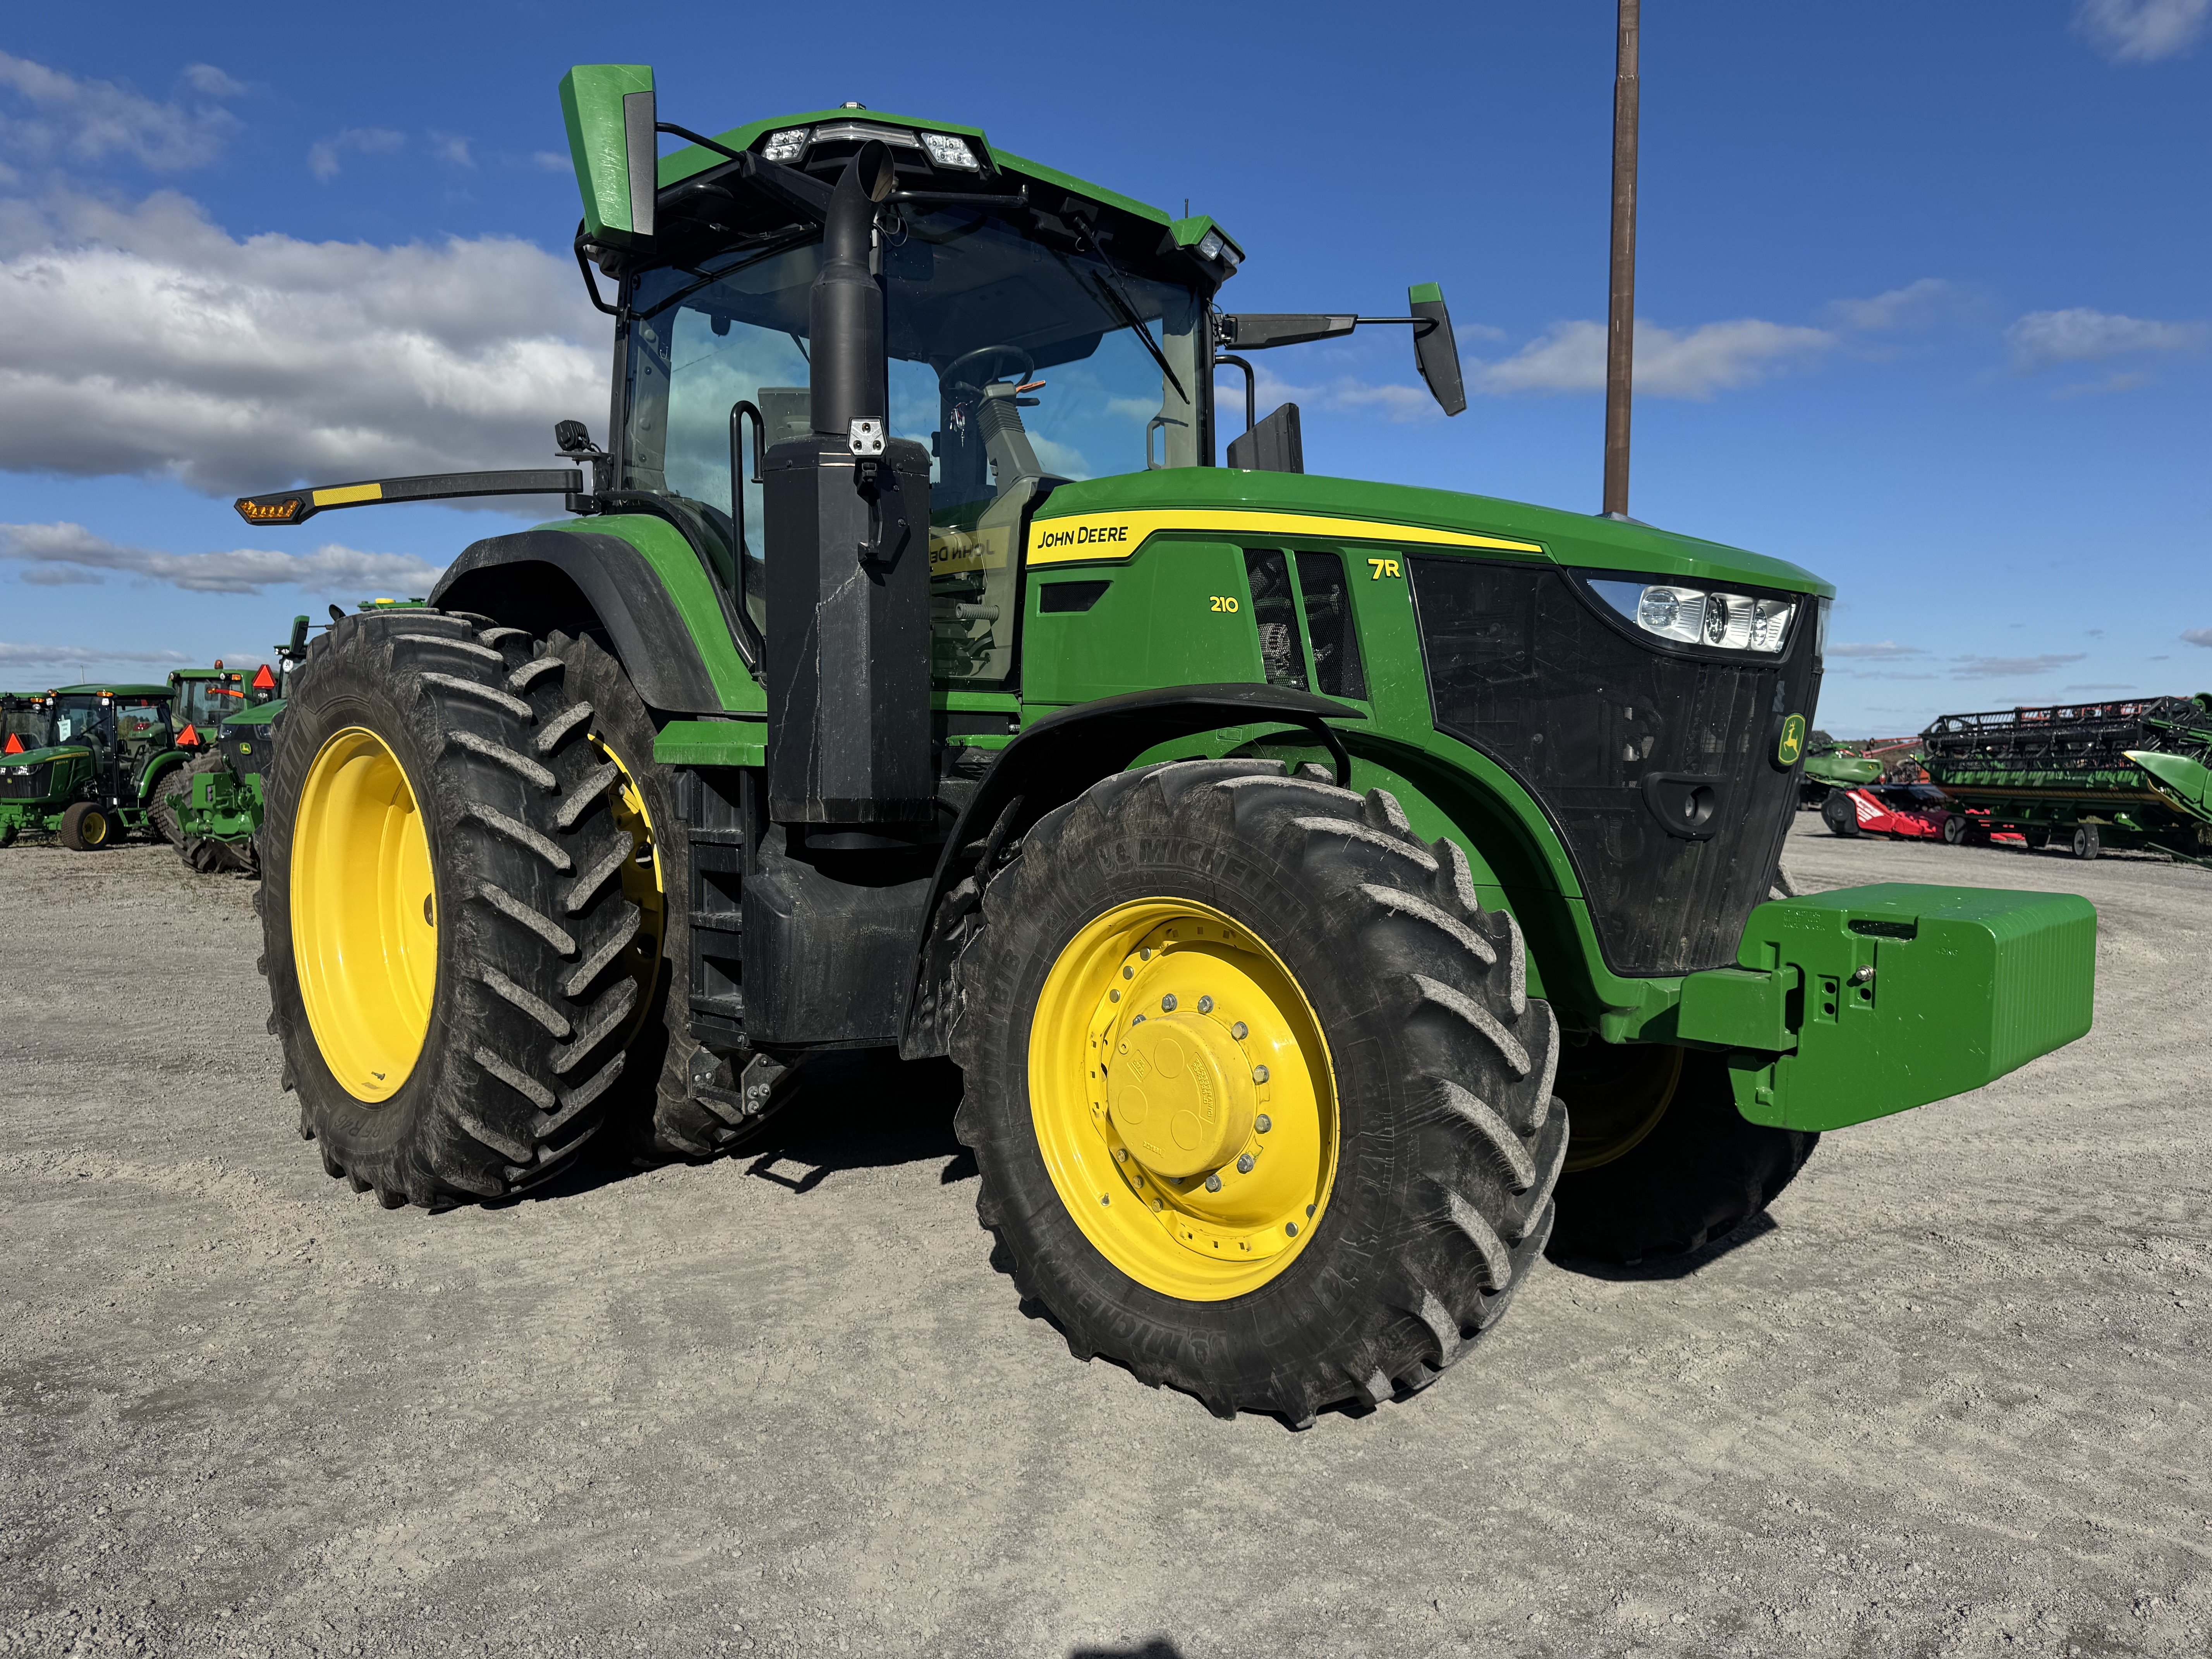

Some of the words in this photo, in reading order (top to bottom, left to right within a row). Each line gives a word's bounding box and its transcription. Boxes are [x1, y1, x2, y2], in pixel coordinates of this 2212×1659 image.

[1037, 531, 1074, 549] JOHN
[1077, 526, 1128, 544] DEERE
[1367, 558, 1401, 580] 7R
[1209, 596, 1239, 613] 210
[1135, 837, 1303, 931] MICHELIN
[983, 946, 1022, 1102] OMNIBIB
